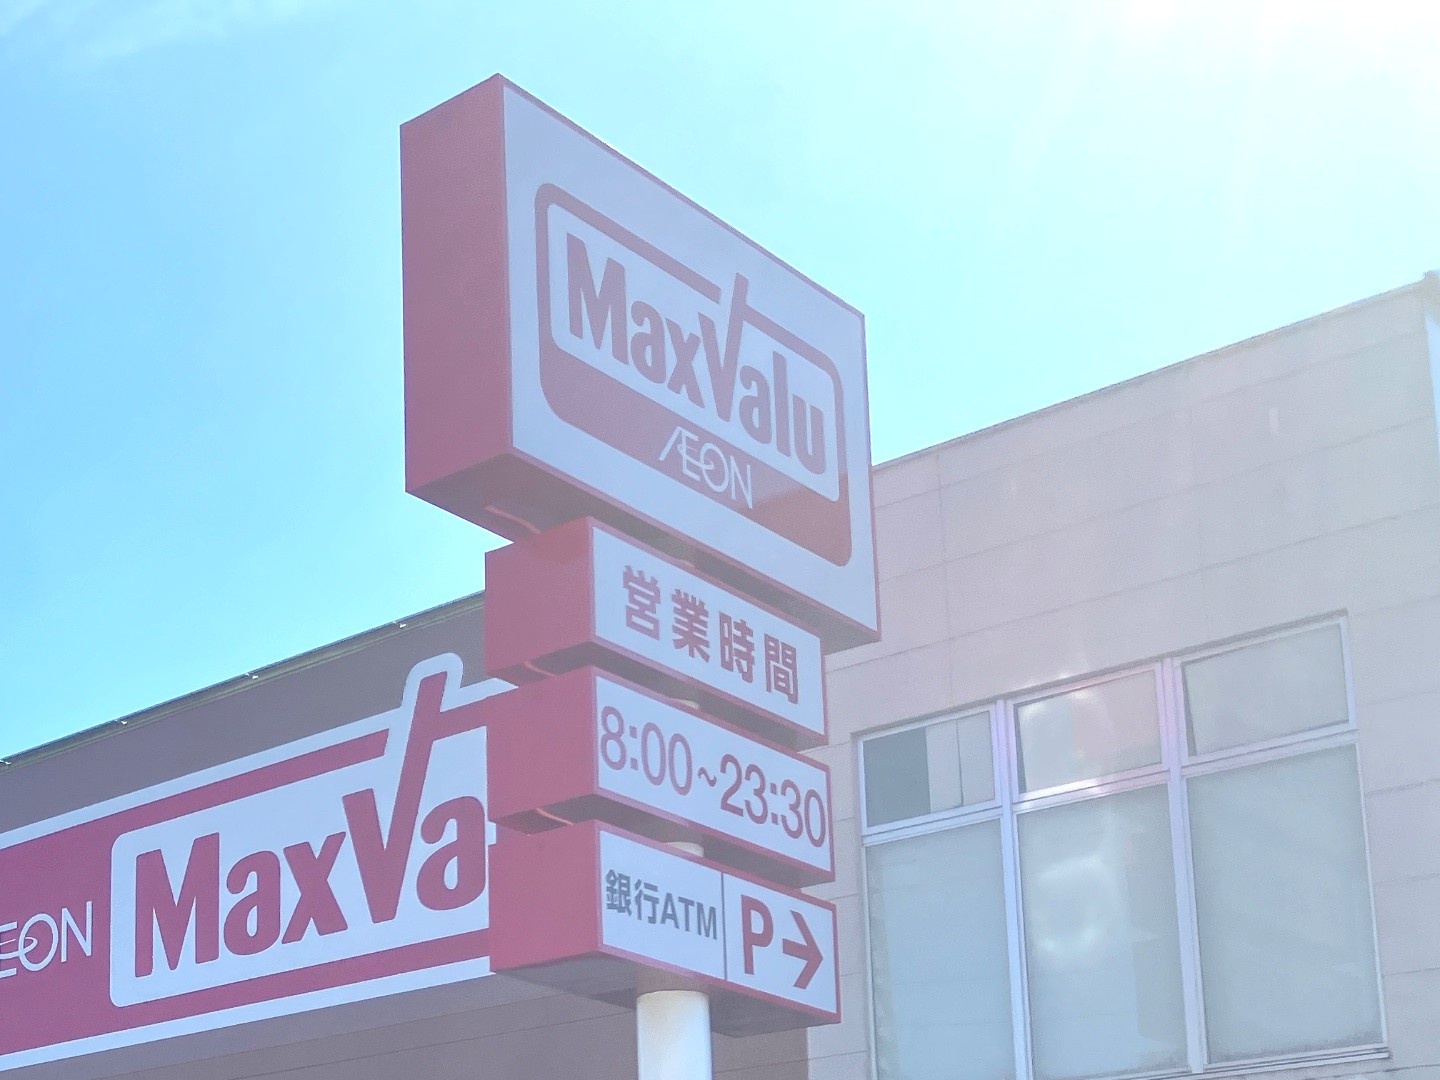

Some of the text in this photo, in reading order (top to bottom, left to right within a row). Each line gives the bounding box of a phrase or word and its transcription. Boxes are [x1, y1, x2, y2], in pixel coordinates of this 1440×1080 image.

[566, 232, 826, 475] MaxValu
[622, 565, 800, 704] 営業時間
[134, 671, 488, 978] MaxVa
[605, 868, 718, 940] 銀行ATM
[740, 893, 775, 975] P
